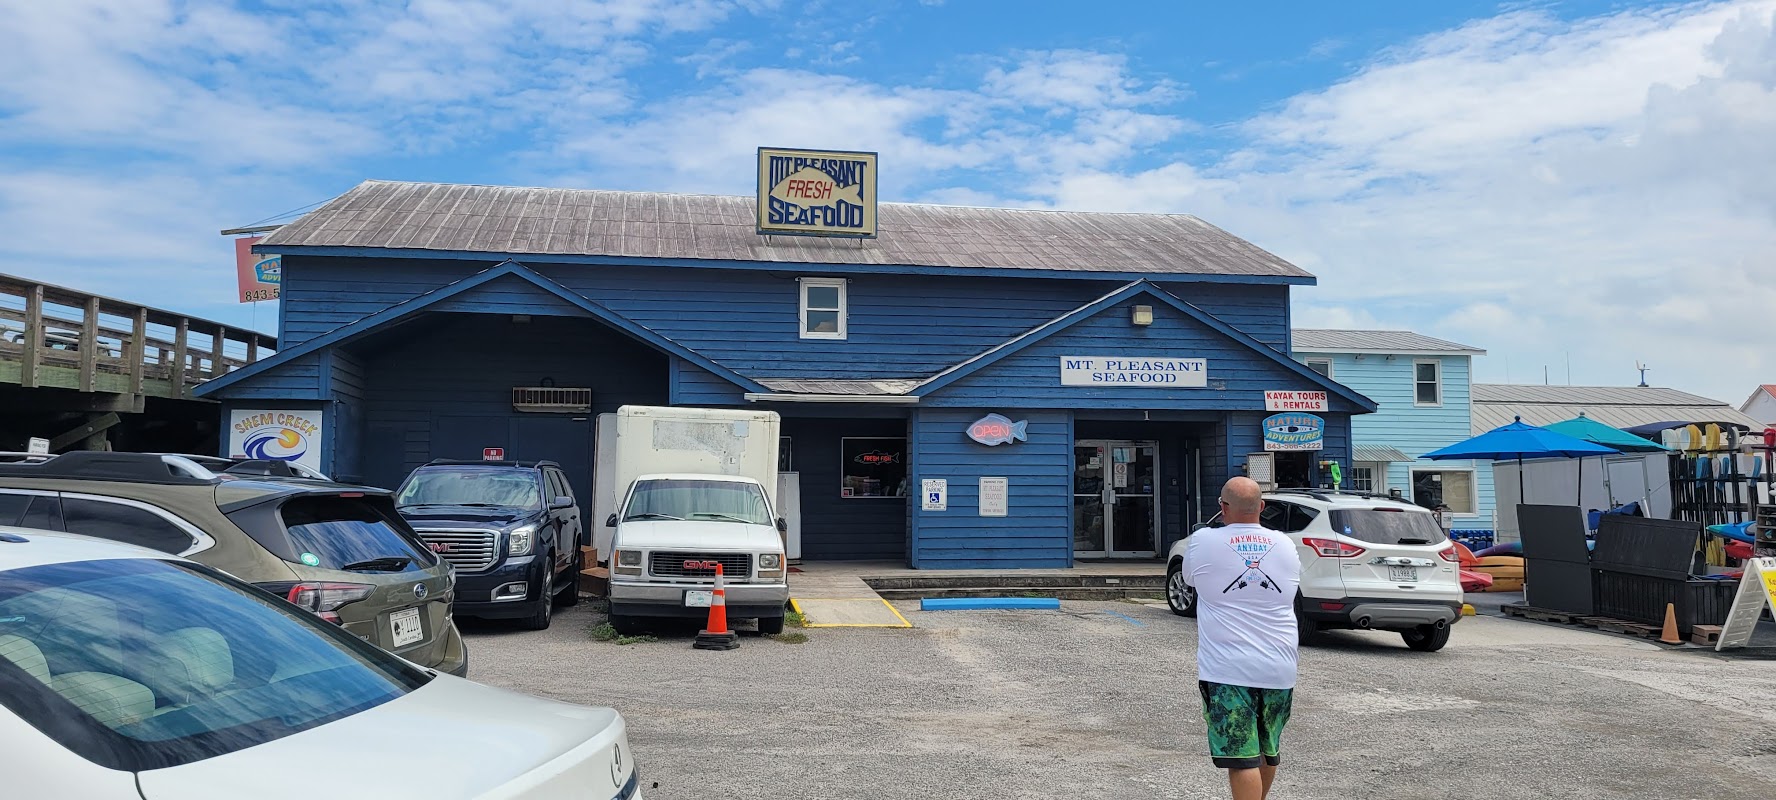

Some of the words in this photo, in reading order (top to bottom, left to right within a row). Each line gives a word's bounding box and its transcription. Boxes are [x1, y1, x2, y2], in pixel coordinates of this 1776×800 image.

[793, 157, 868, 203] PLEASANT
[786, 179, 833, 200] FRESH
[768, 195, 864, 228] SEAFOOD
[1066, 360, 1097, 370] MT.
[1105, 360, 1203, 372] PLEASANT
[1092, 372, 1177, 383] SEAFOOD
[1266, 392, 1294, 400] KAYAK
[1297, 392, 1326, 400] TOURS
[1273, 401, 1279, 409] &
[1283, 401, 1321, 409] RENTALS
[234, 412, 275, 434] SHEM
[276, 412, 318, 437] CREEK
[1266, 417, 1319, 427] NATURE
[973, 425, 1010, 437] OPEN
[1266, 430, 1321, 442] ADVENTURES
[1230, 534, 1273, 545] ANYWHERE
[683, 560, 718, 569] GMC
